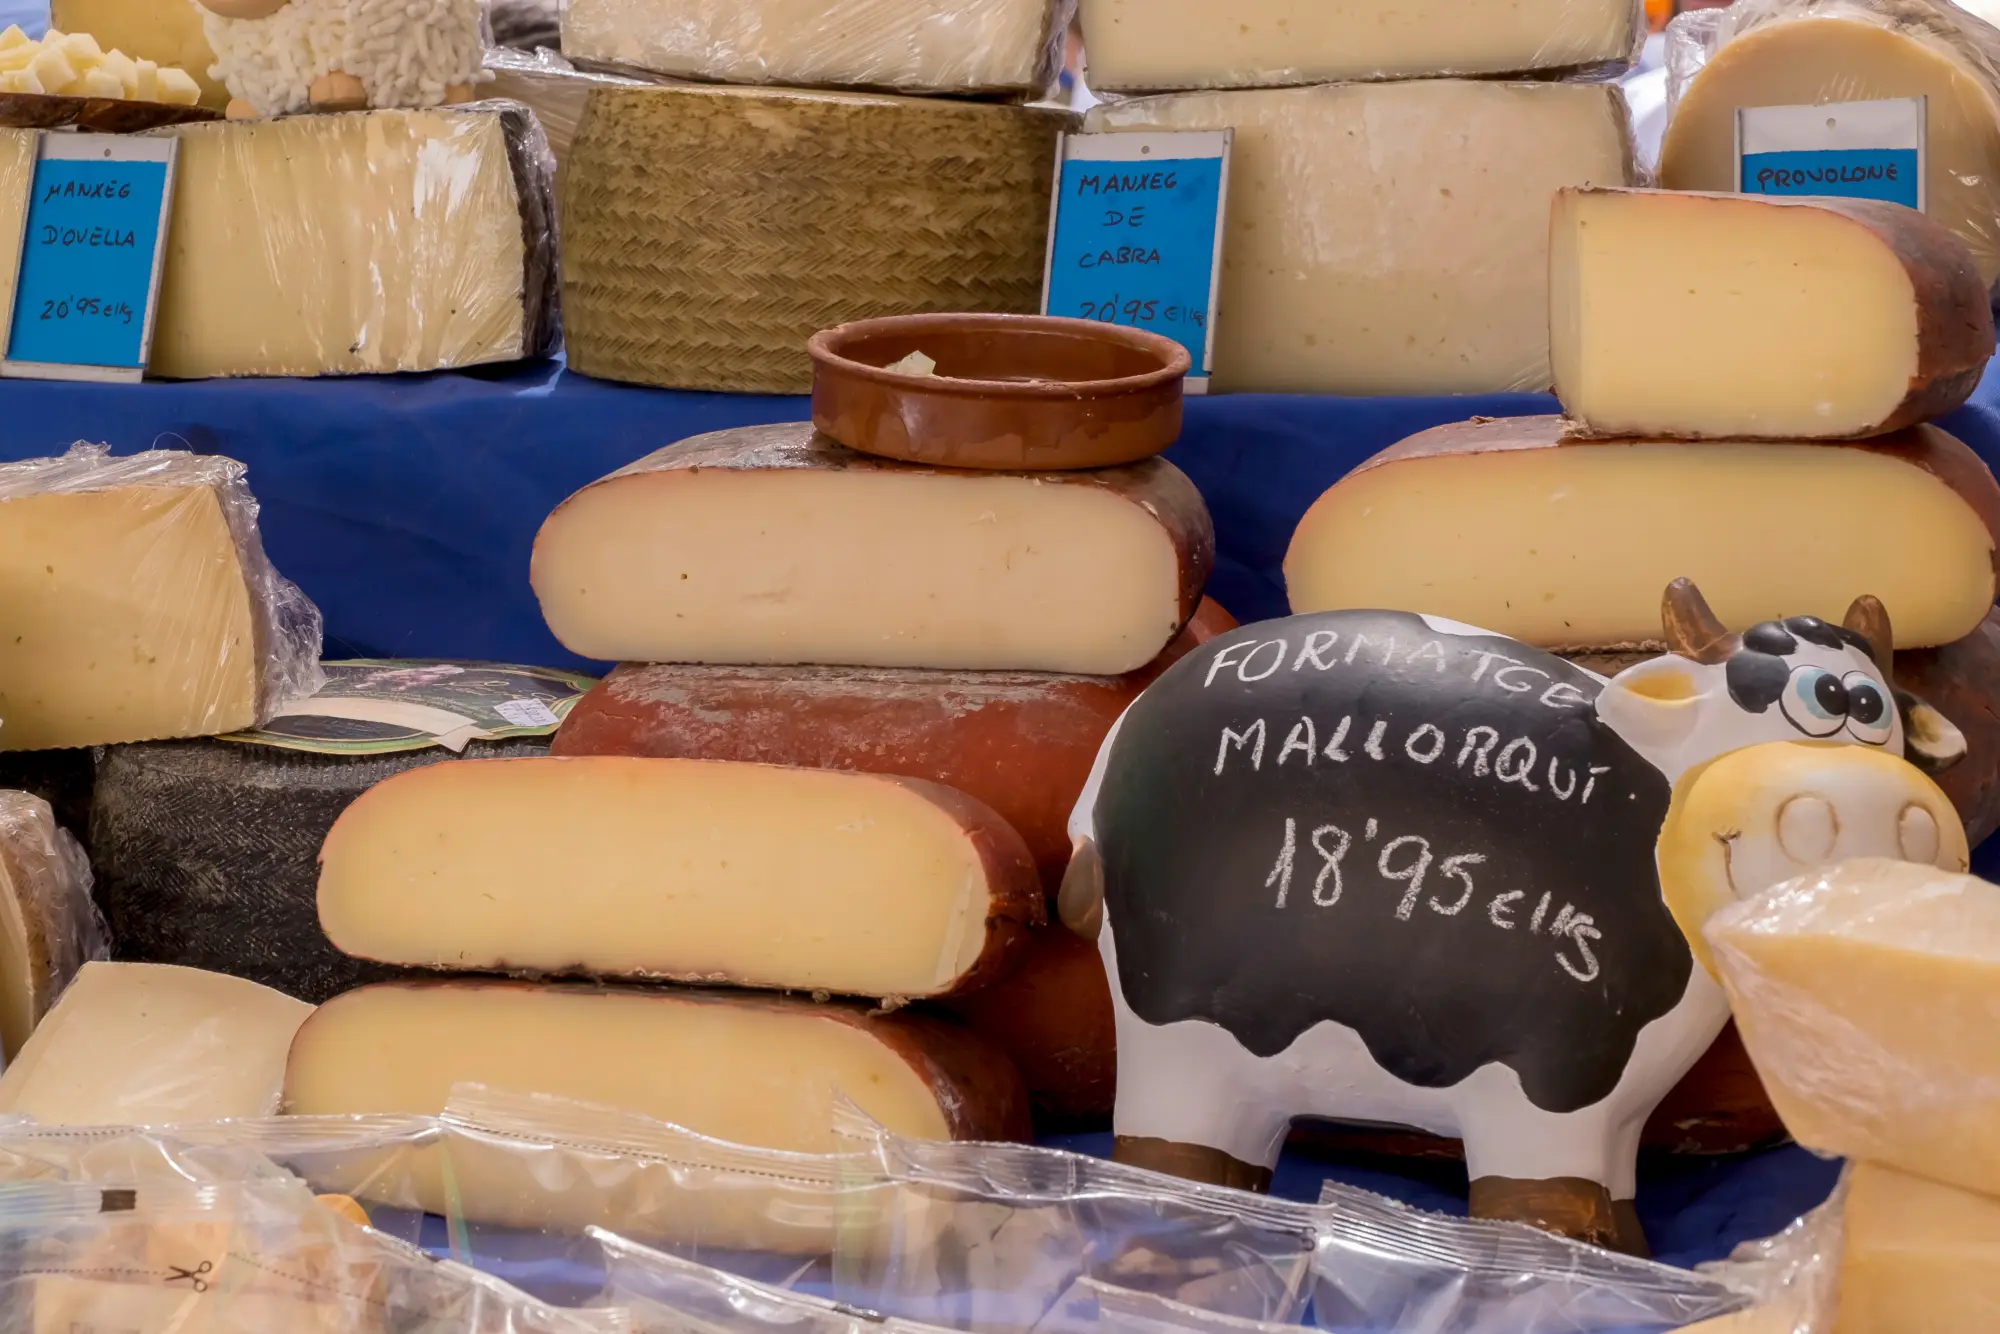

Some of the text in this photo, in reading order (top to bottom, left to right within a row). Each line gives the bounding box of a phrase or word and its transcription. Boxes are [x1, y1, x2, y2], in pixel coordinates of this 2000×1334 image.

[1078, 172, 1178, 196] MANXEG
[1756, 162, 1899, 193] PROVOLONE
[44, 180, 132, 204] MANXEG
[1102, 206, 1146, 227] DE
[41, 225, 135, 248] D'OVELLA
[1079, 246, 1161, 269] CABRA
[1203, 630, 1592, 709] FORMATGE
